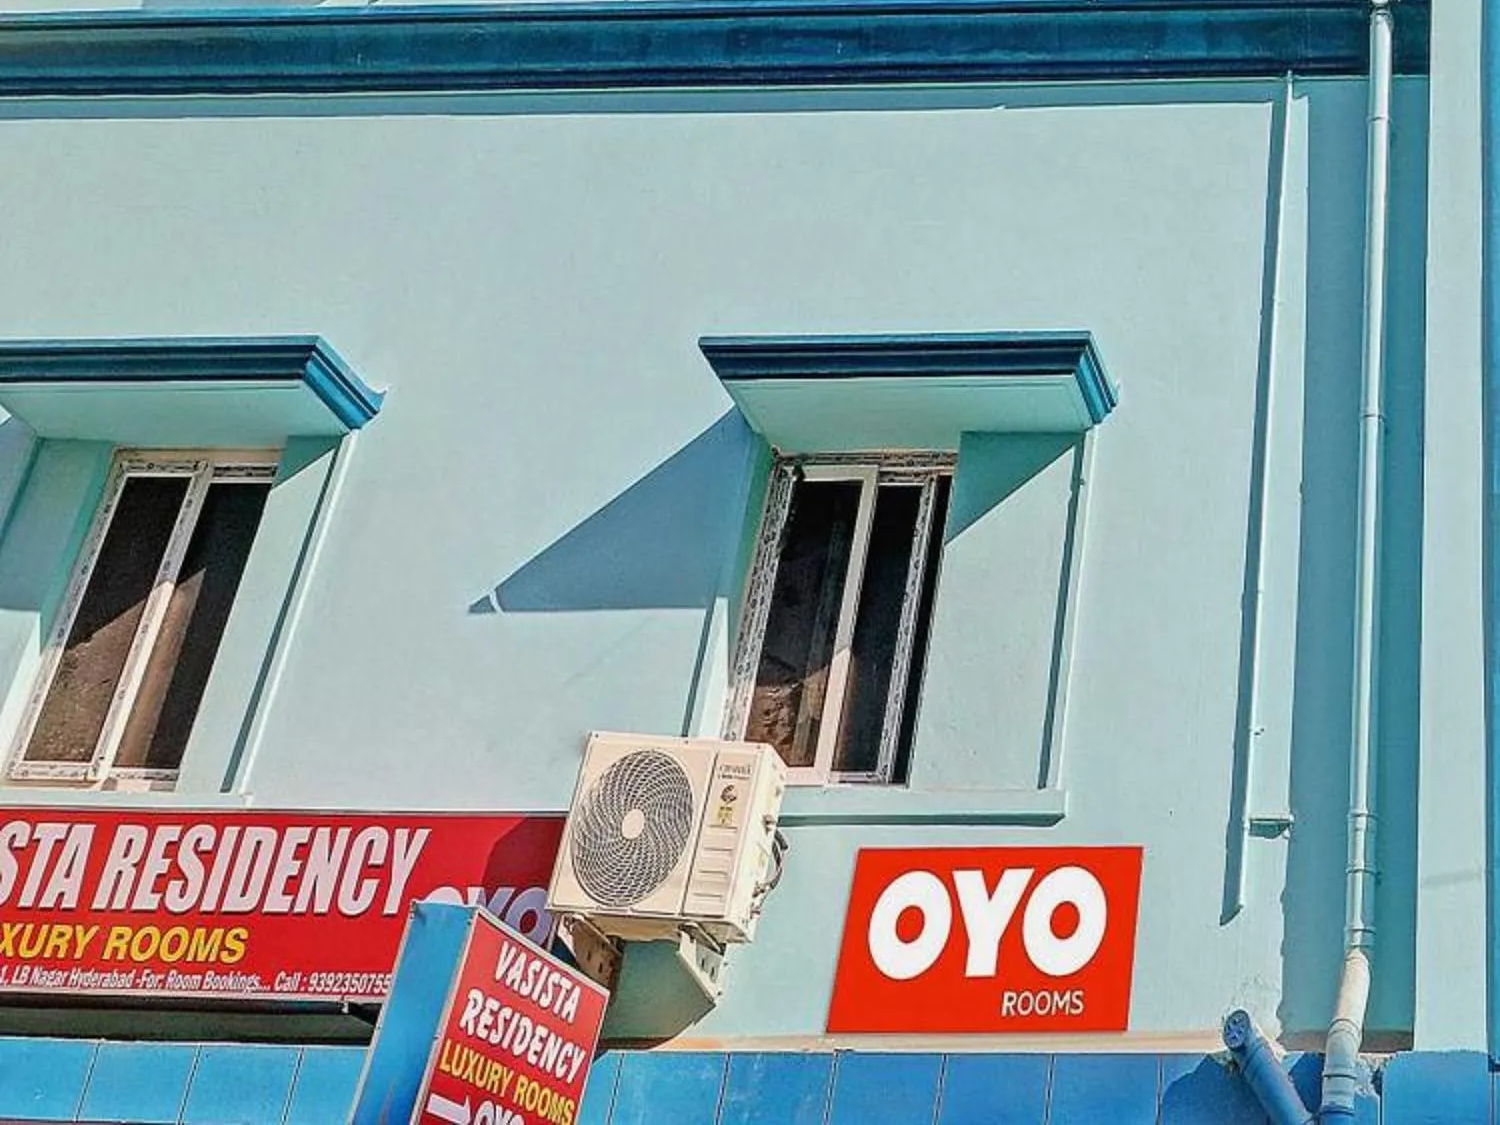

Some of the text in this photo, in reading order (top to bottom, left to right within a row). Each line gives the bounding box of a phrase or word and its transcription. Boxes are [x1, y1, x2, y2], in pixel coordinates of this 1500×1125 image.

[0, 820, 432, 916] STA RESIDENCY
[0, 922, 249, 965] XURY ROOMS
[867, 866, 1108, 979] OYO
[12, 965, 30, 984] LB
[30, 964, 69, 988] Nagar
[67, 967, 136, 991] Hyderabad
[165, 969, 202, 990] Room
[494, 940, 582, 1024] VASISTA
[1001, 990, 1085, 1016] ROOMS
[459, 988, 586, 1084] RESIDENCY
[439, 1038, 515, 1098] LUXURY
[512, 1075, 576, 1125] ROOMS
